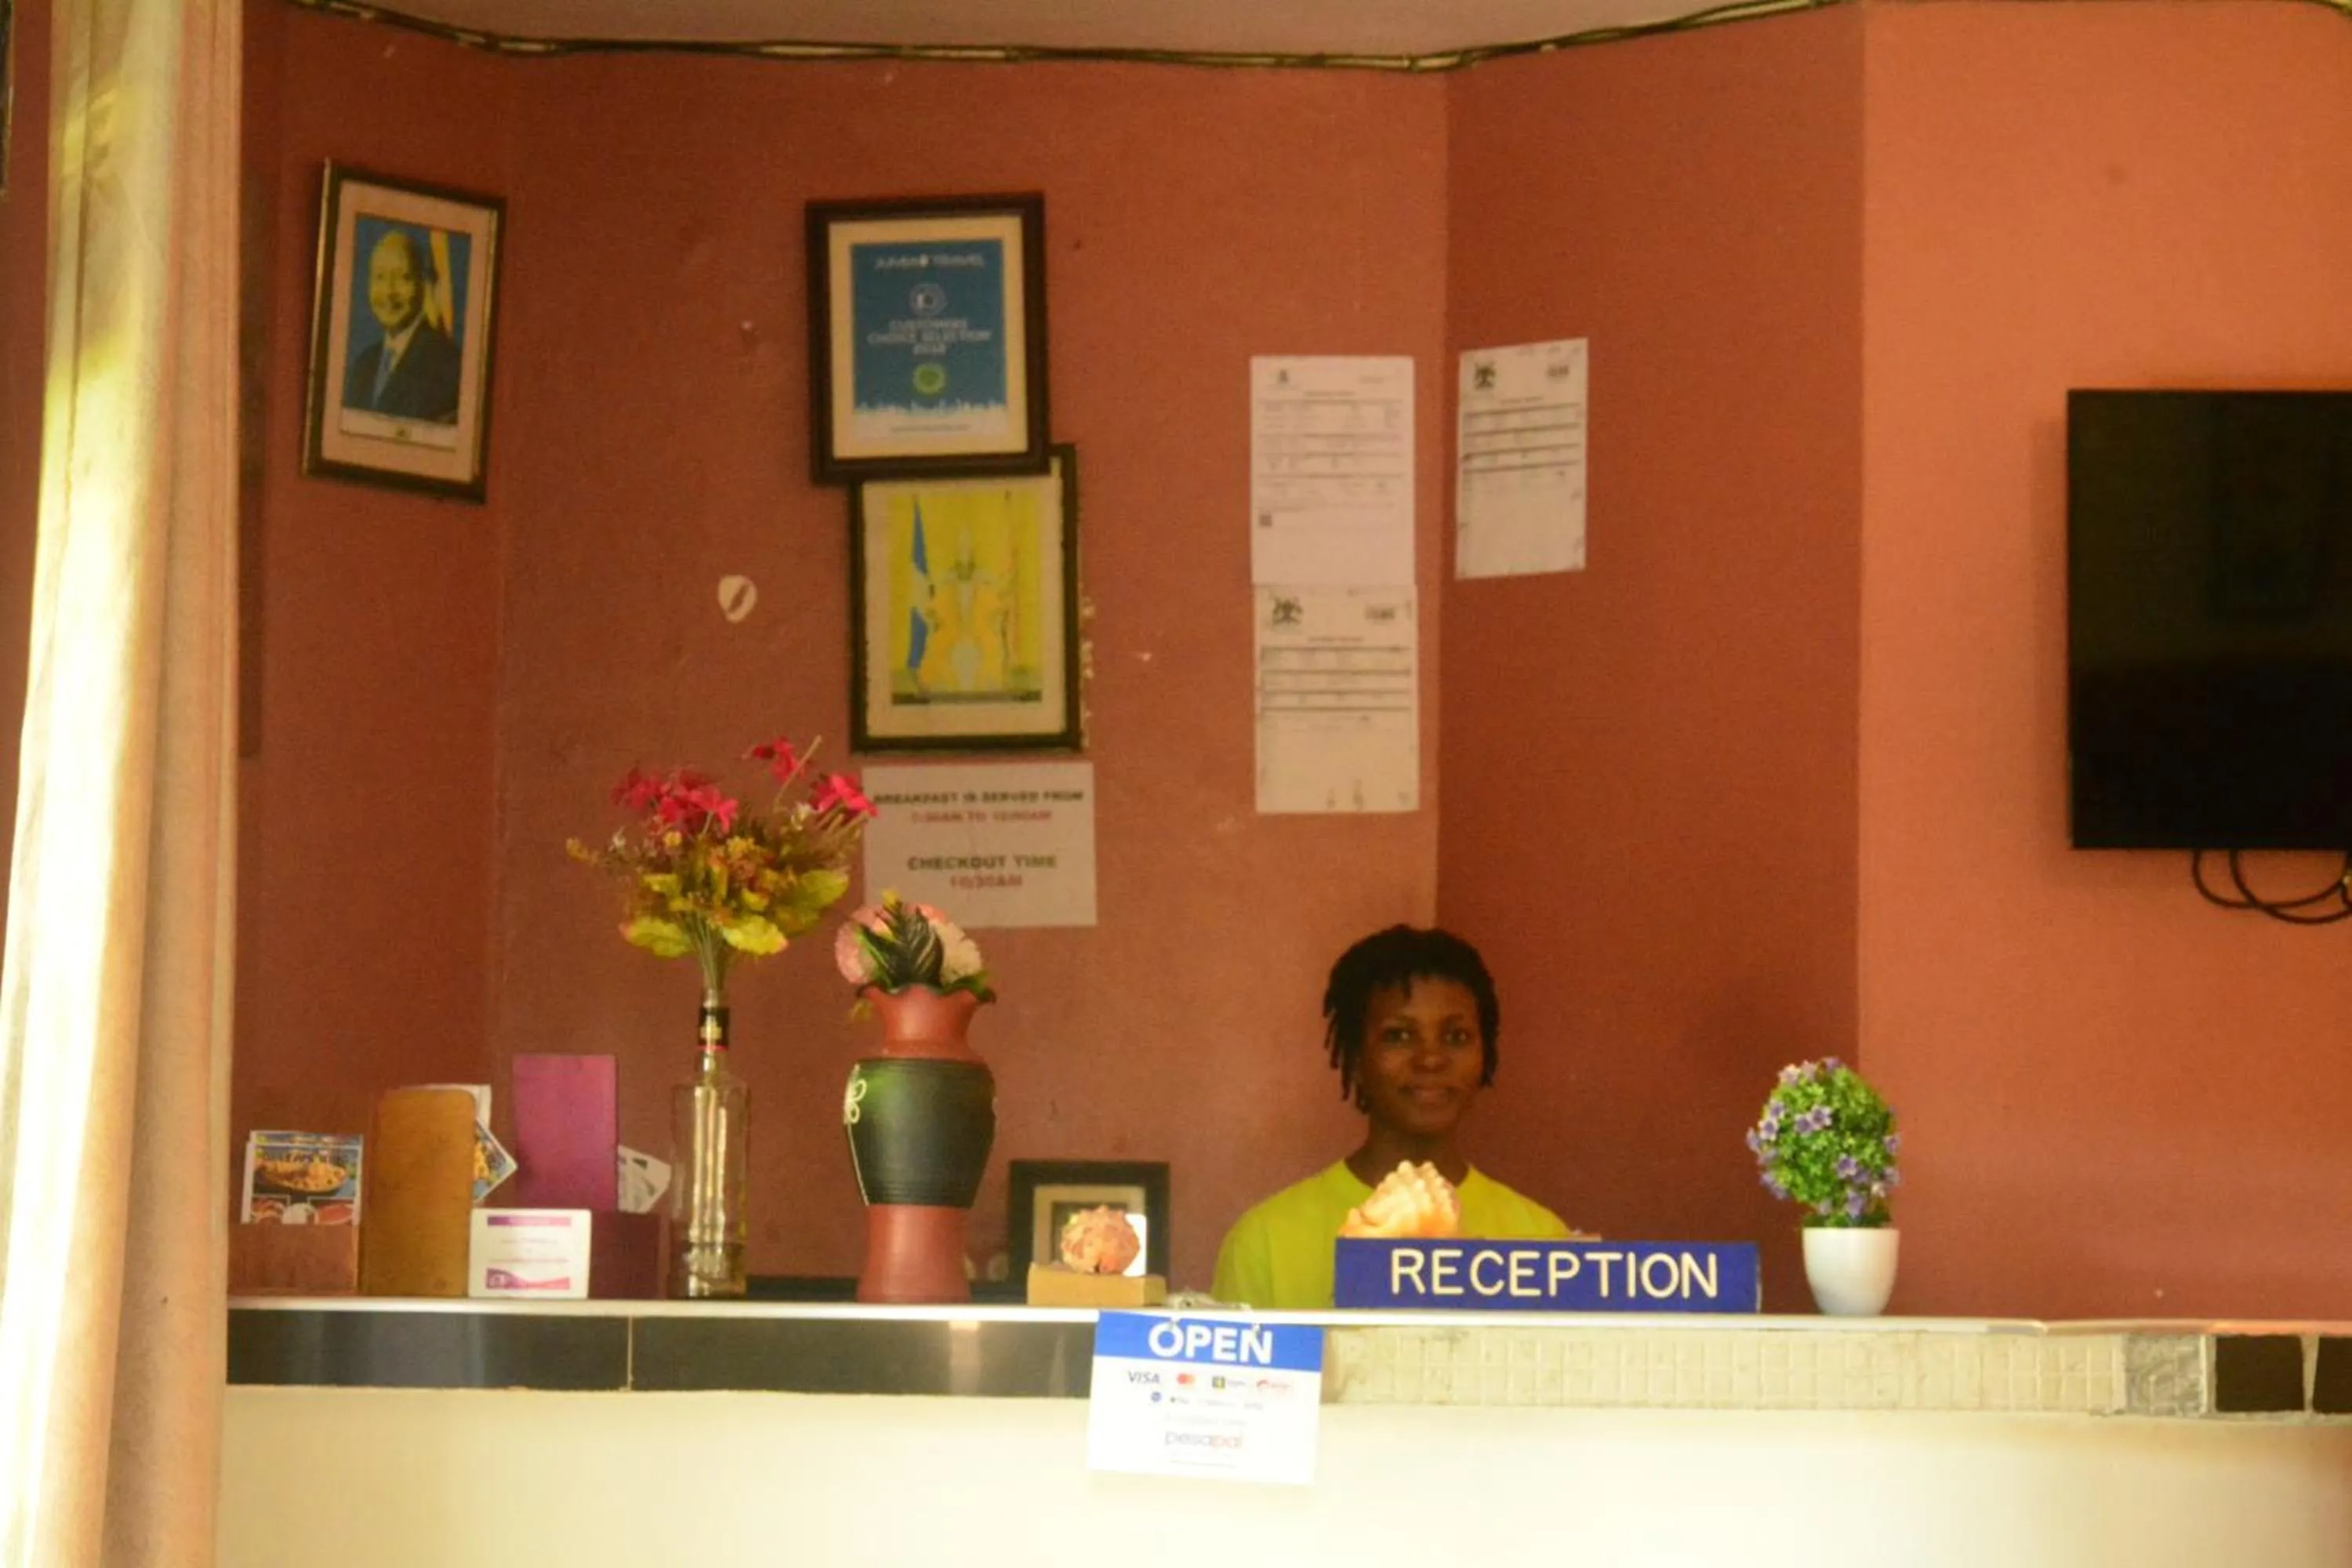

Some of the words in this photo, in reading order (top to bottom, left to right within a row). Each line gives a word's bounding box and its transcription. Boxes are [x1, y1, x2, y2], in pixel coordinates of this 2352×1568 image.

[873, 791, 958, 804] BREAKFAST
[982, 791, 1039, 803] SERVED
[1043, 790, 1083, 801] FROM
[967, 810, 987, 822] TO
[907, 855, 1007, 870] CHECKOUT
[1013, 855, 1057, 869] TIME
[1391, 1248, 1718, 1298] RECEPTION
[1148, 1322, 1273, 1364] OPEN
[1127, 1370, 1160, 1385] VISA
